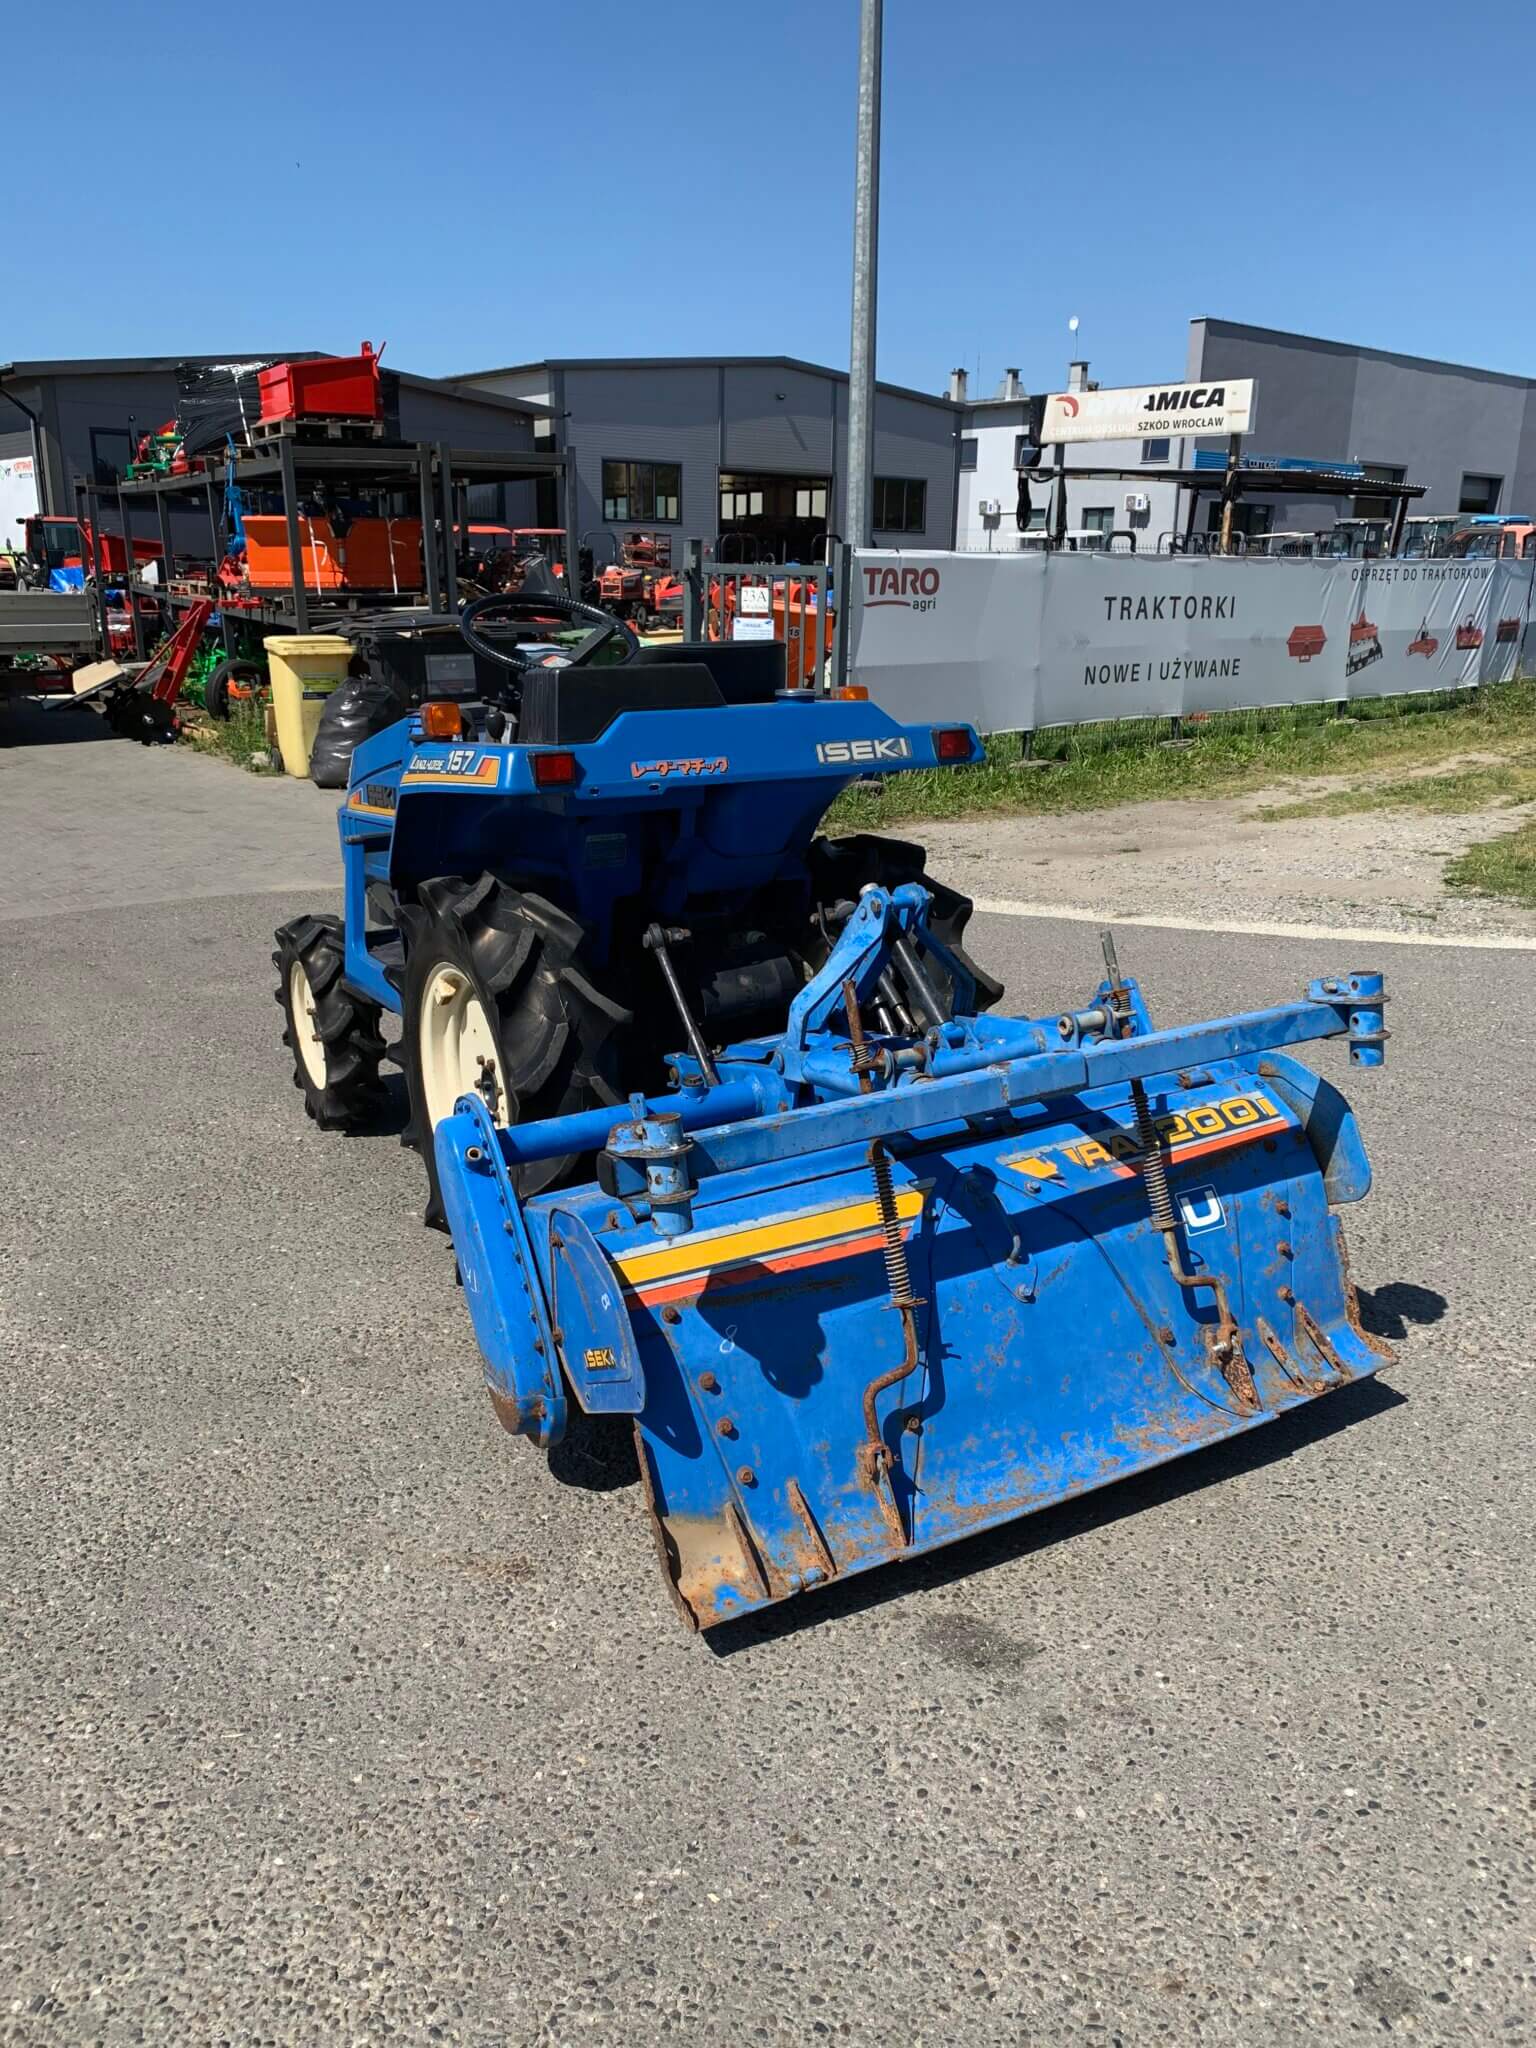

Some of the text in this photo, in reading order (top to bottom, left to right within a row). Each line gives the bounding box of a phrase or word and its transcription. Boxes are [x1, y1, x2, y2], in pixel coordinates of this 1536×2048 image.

[1137, 419, 1170, 432] SZKÓD
[1172, 416, 1225, 430] WROCŁAW
[863, 567, 940, 595] TARO
[1351, 567, 1490, 584] OSPRZĘT DO TRAKTORKÓW
[912, 597, 937, 612] agri
[1104, 595, 1235, 621] TRAKTORKI
[1084, 657, 1241, 686] NOWE I UŻYWANE
[447, 750, 476, 772] 157
[816, 738, 908, 763] ISEKI
[631, 757, 730, 779] レーダーマチック
